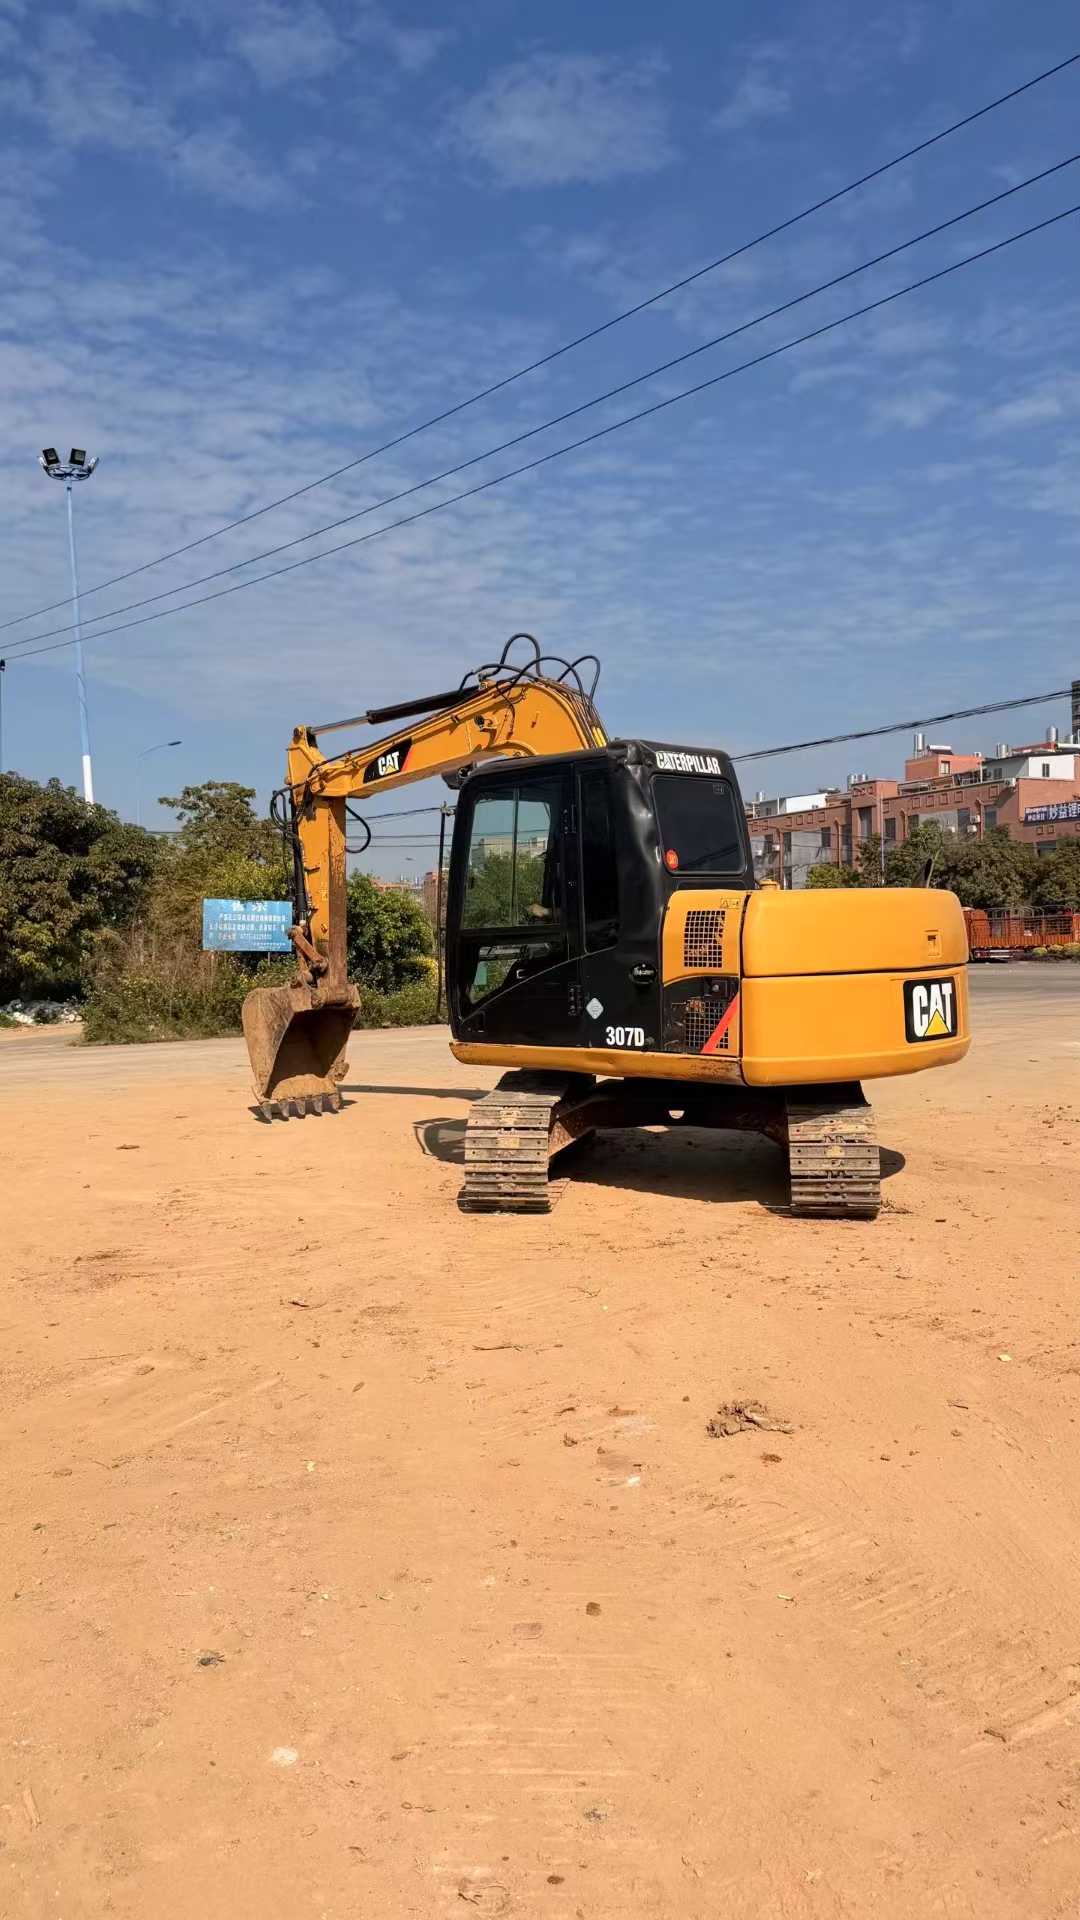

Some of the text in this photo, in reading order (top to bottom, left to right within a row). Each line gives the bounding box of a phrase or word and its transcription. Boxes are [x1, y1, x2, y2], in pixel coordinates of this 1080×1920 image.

[377, 751, 400, 776] CAT
[655, 751, 721, 775] CATERPILLAR
[912, 982, 953, 1038] CAT
[605, 1026, 645, 1047] 307D
